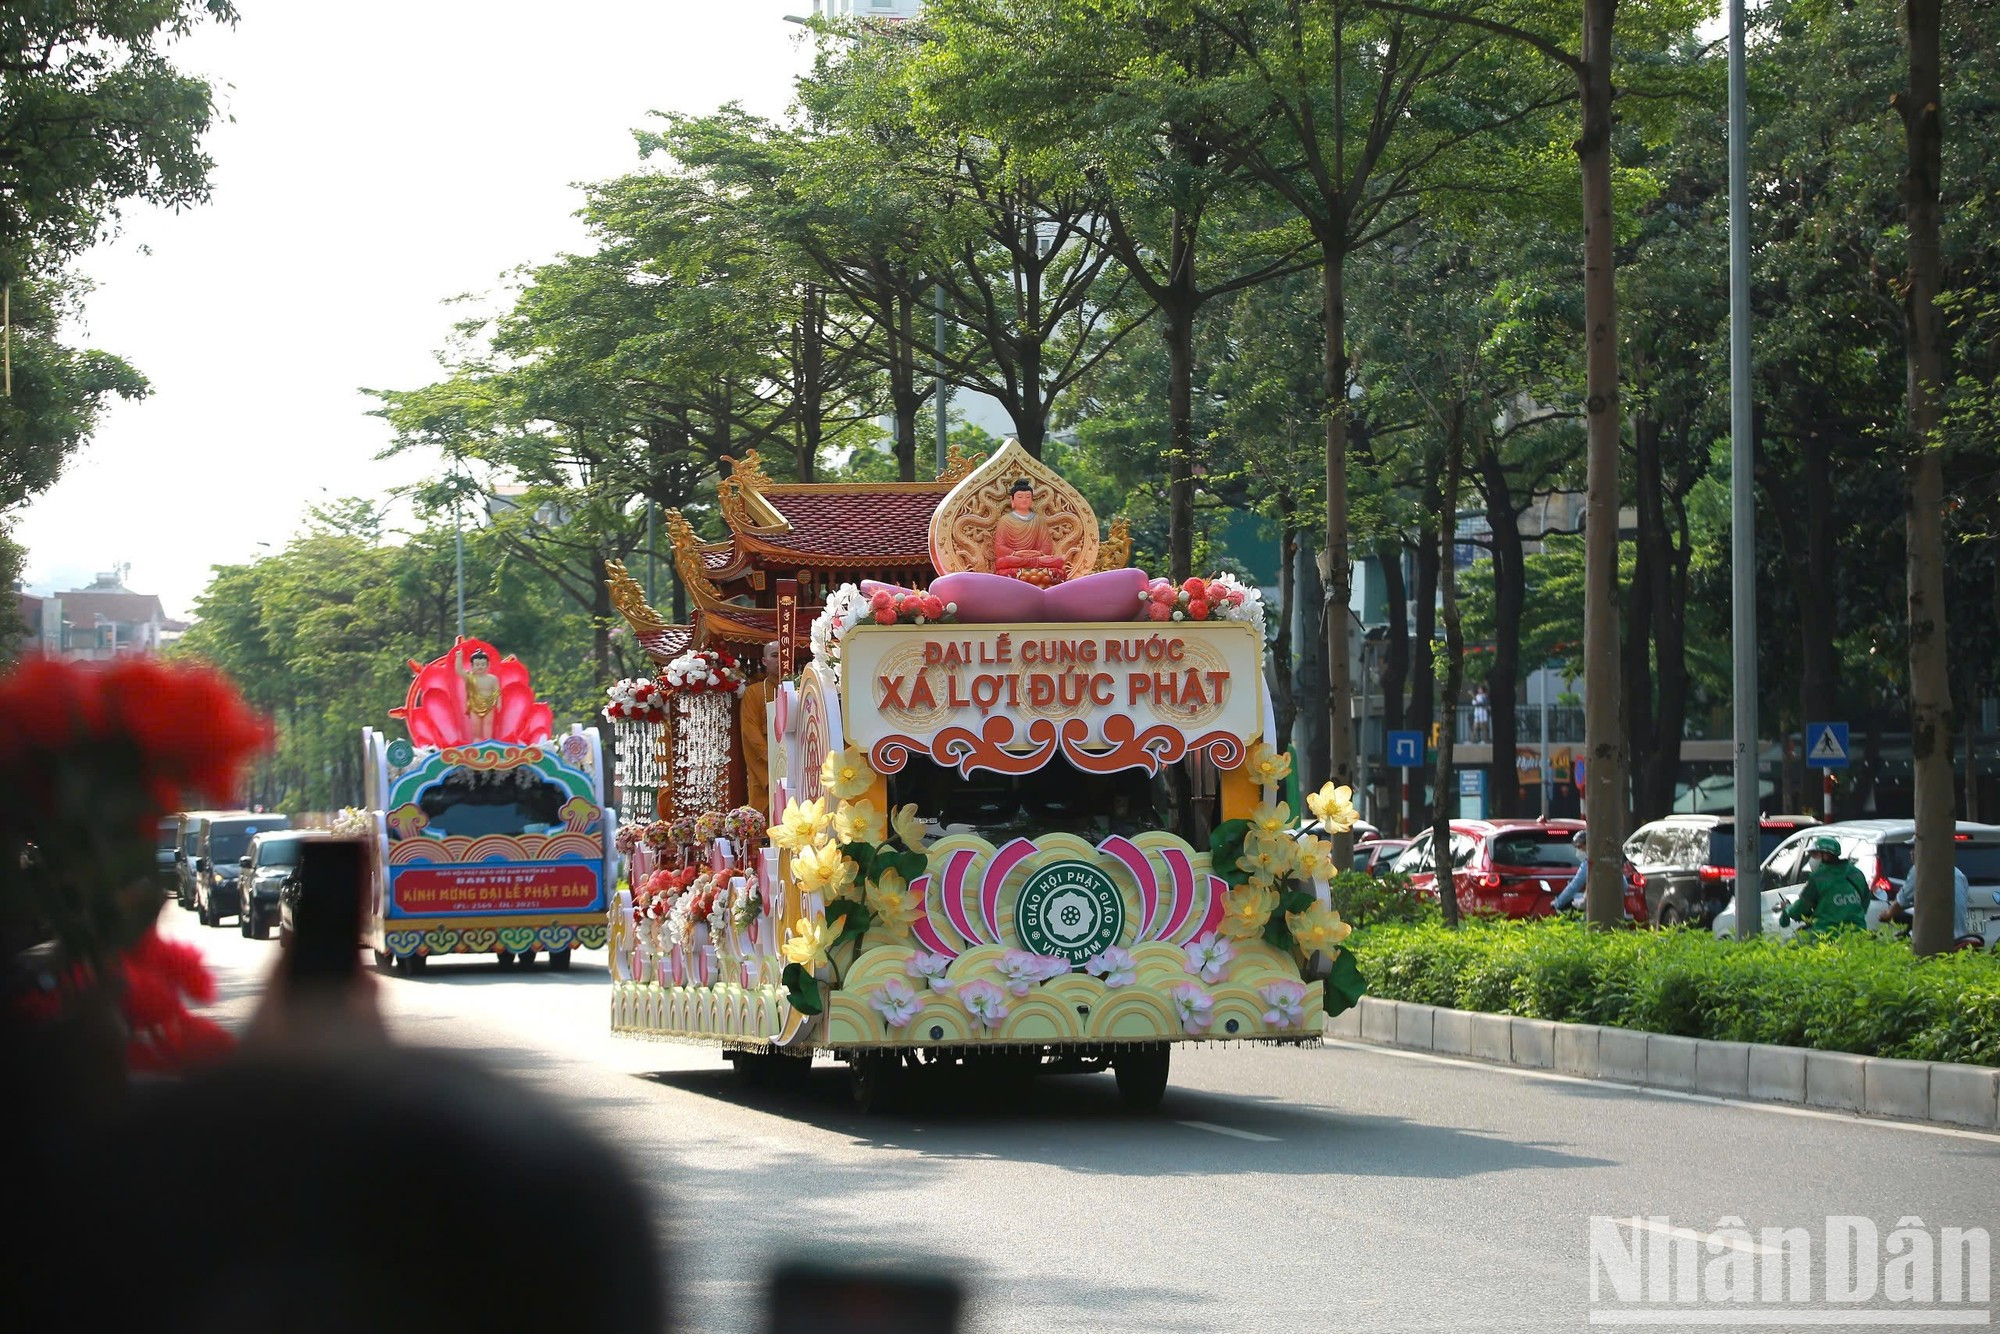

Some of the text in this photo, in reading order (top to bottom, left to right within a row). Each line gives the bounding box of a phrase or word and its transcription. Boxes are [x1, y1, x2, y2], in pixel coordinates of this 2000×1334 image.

[922, 632, 1185, 670] ĐẠI LỄ CUNG RƯỚC
[878, 665, 1231, 715] XÁ LỢI ĐỨC PHẬT
[456, 876, 486, 884] BAN
[403, 887, 436, 901] KÍNH
[524, 882, 558, 900] PHẬT
[1027, 872, 1115, 926] GIÁO HỘI PHẬT GIÁO
[1833, 891, 1862, 906] Grab
[1074, 940, 1102, 960] NAM
